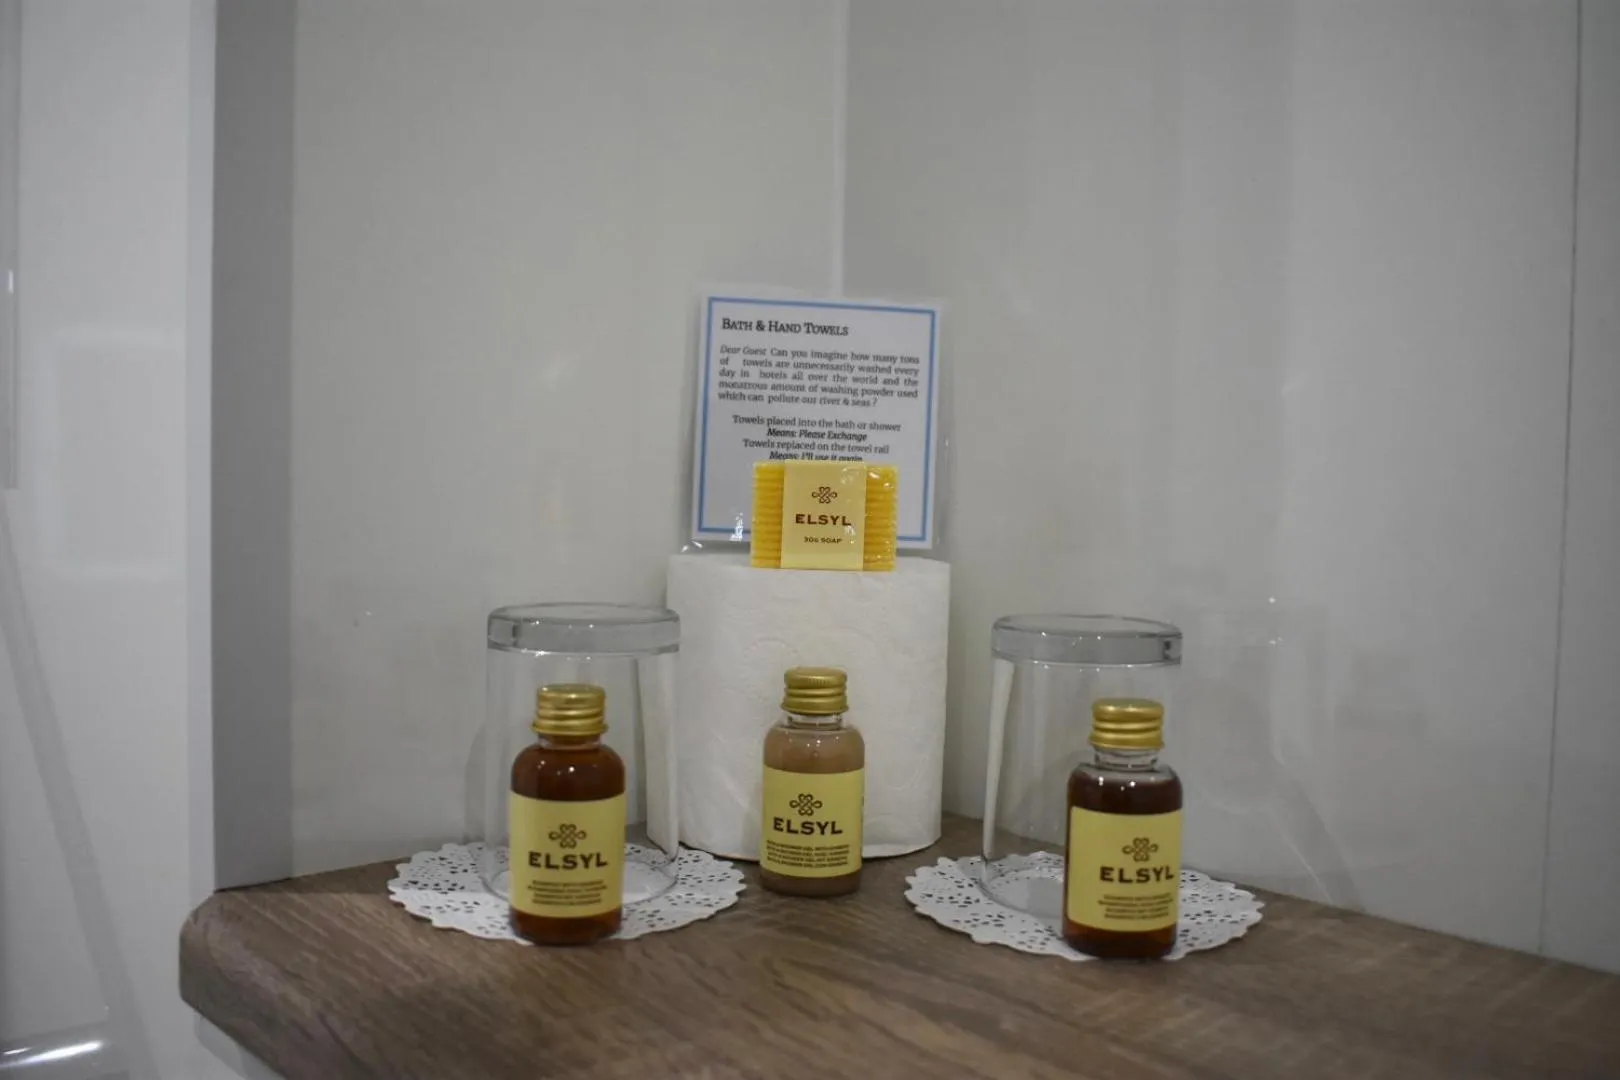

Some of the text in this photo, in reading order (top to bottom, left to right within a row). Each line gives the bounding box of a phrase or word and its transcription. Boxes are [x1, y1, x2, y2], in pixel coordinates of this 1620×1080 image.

[756, 319, 766, 332] &
[720, 344, 920, 364] Dear Guest Can you imagine how many tons
[720, 356, 920, 377] of towels are unnecessarily washed every
[718, 367, 919, 386] day in hotels all over the world and the
[718, 380, 918, 398] monstrous amount of washing powder used
[718, 390, 746, 401] which
[748, 394, 764, 402] can
[767, 392, 800, 404] pollute
[801, 396, 816, 404] our
[819, 396, 841, 405] river
[732, 414, 902, 432] Towels placed into the bath or shower
[766, 428, 868, 442] Means: Please Exchange
[742, 438, 890, 454] Towels replaced on the towel rail
[795, 514, 852, 526] ELSYL
[772, 816, 844, 836] ELSYL
[528, 850, 608, 870] ELSYL
[1100, 865, 1175, 884] ELSYL
